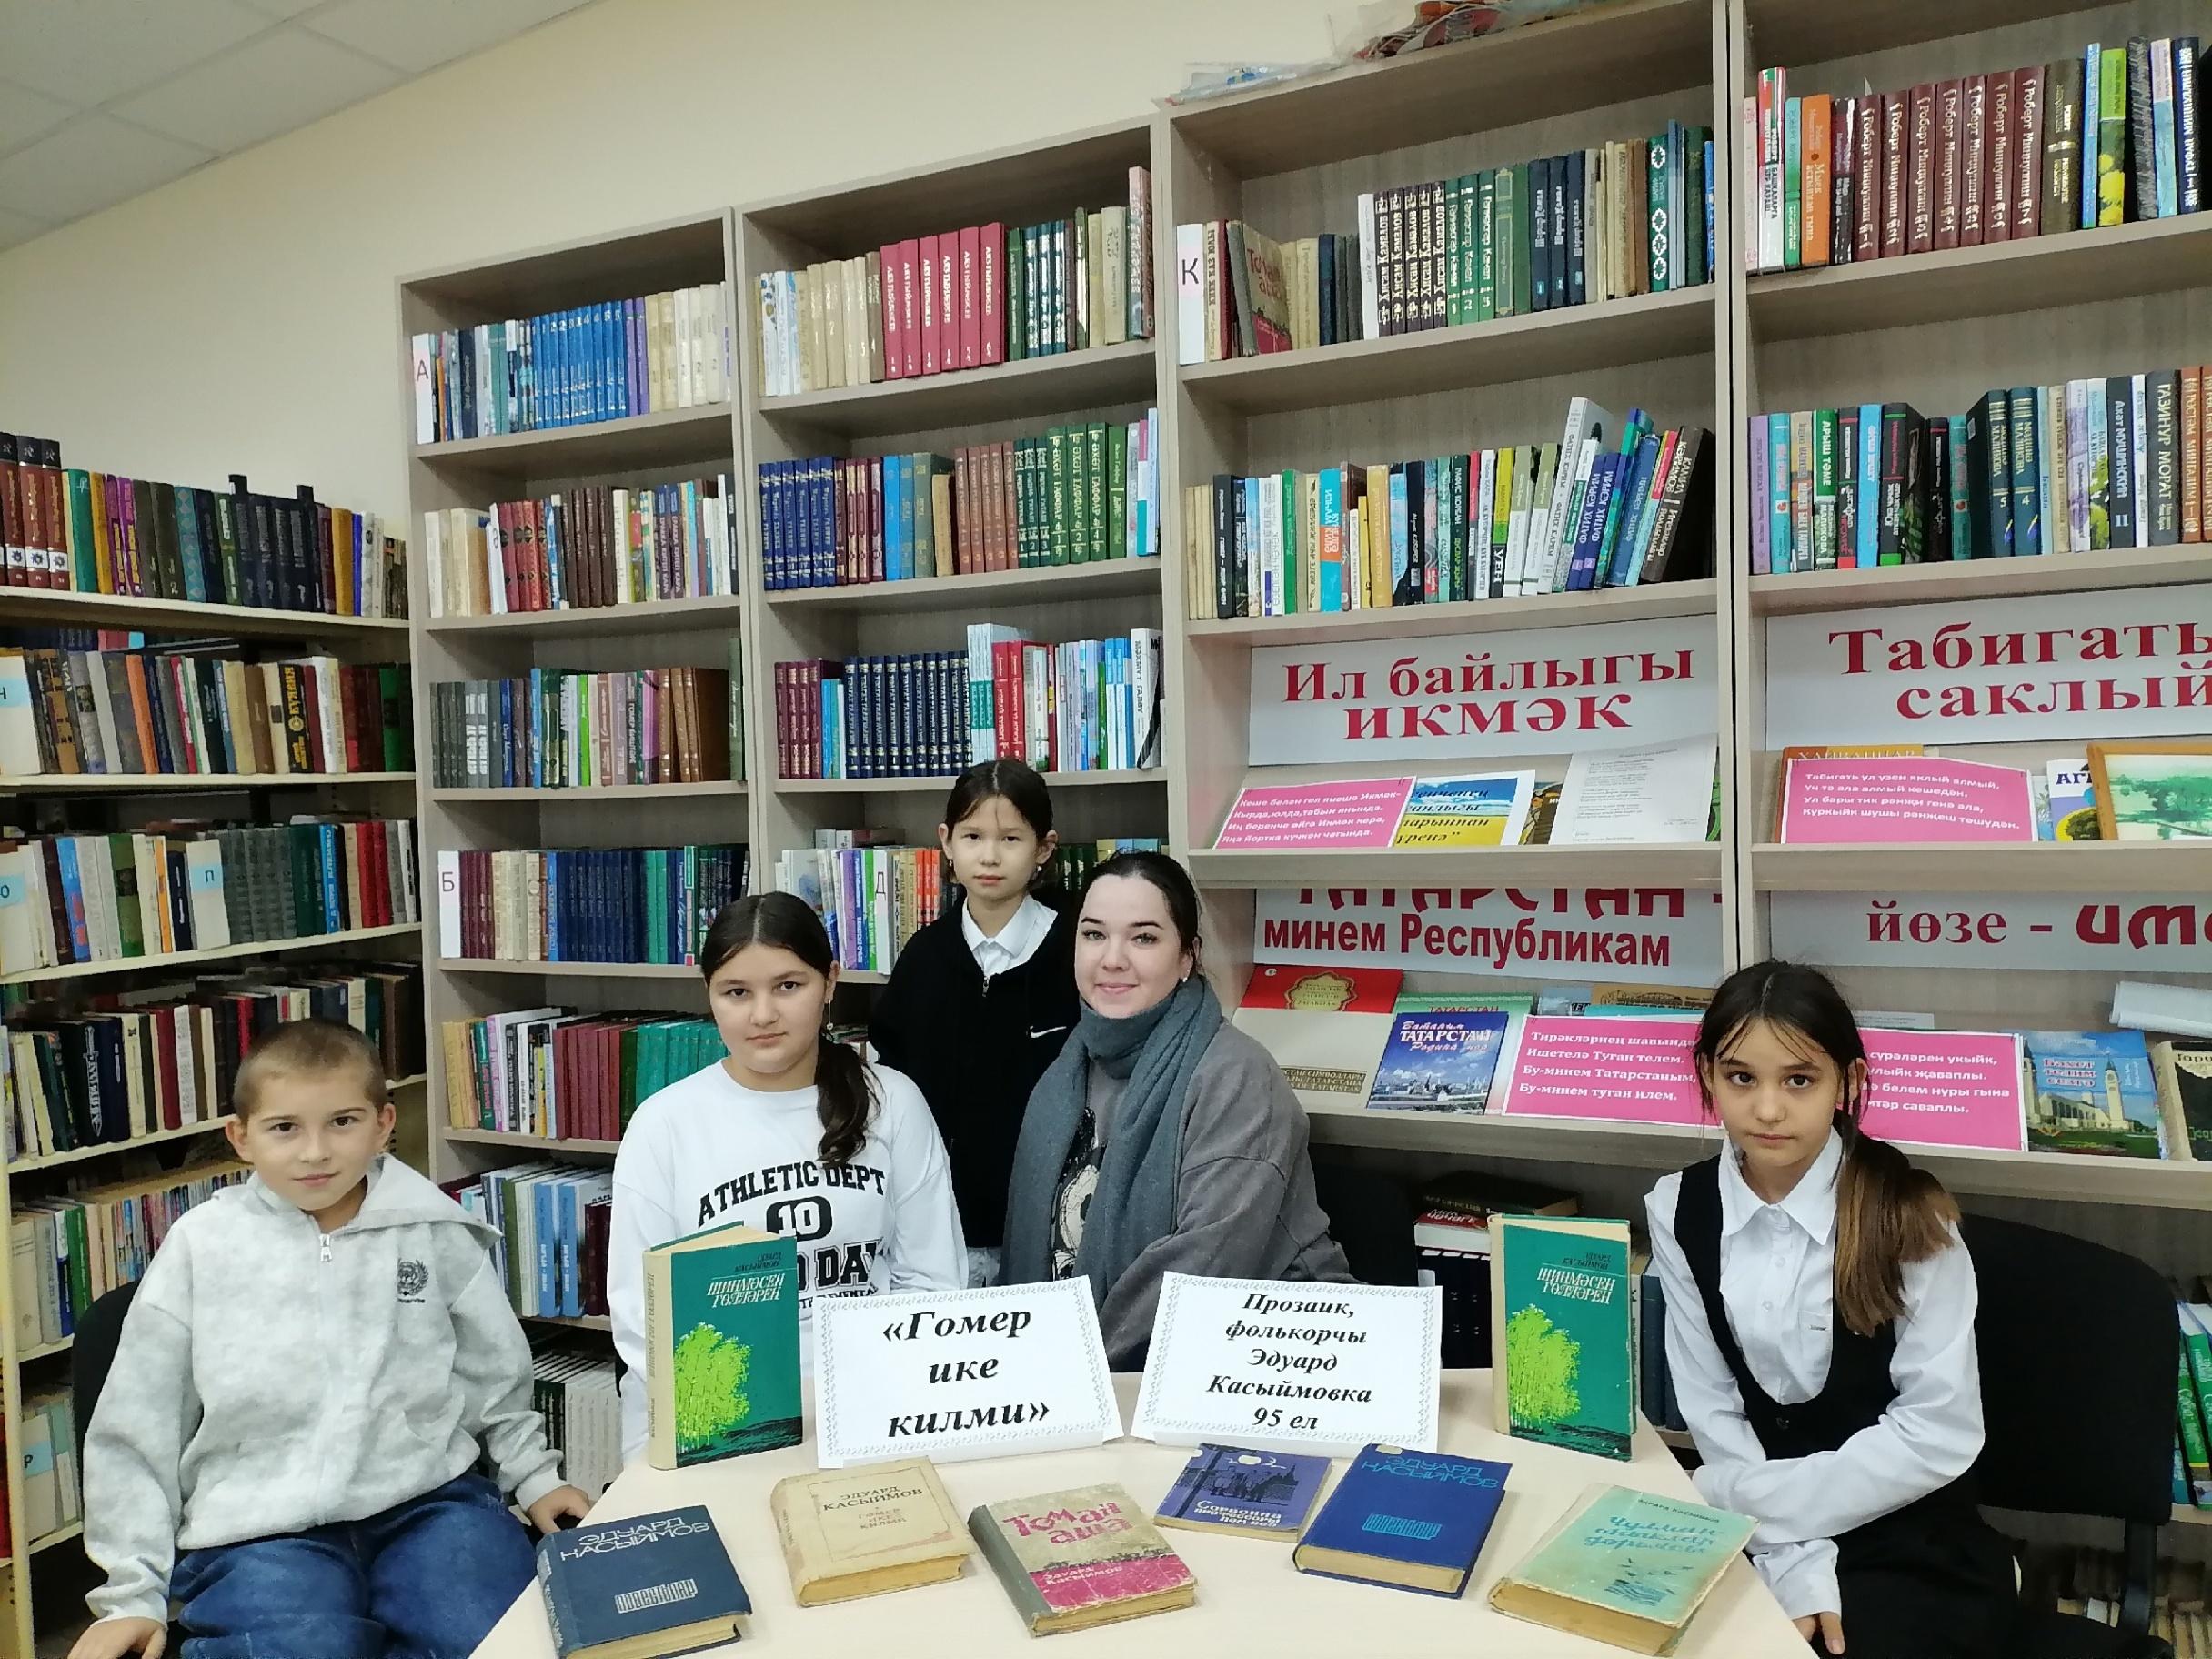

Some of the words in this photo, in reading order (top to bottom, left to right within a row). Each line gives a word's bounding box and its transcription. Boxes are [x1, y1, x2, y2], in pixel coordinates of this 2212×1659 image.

[1941, 98, 1956, 140] Роберт
[2022, 87, 2036, 129] Роберт
[1887, 113, 1903, 152] Роберт
[1181, 257, 1200, 286] К
[416, 359, 430, 382] А
[2157, 383, 2173, 446] ГАЗИНУР
[1822, 420, 1832, 456] АРЫШ
[2157, 450, 2172, 500] МОРАТ
[1492, 547, 1505, 584] УЕН
[1282, 661, 1366, 702] Ил
[1388, 649, 1695, 697] байлыгы
[1342, 693, 1633, 741] икмәк
[441, 871, 455, 892] Б
[1866, 900, 2008, 945] йөзе
[1264, 917, 1387, 953] минем
[1401, 912, 1672, 970] Республикам
[1399, 1030, 1493, 1043] ТАТАРСТАН
[1593, 1051, 1634, 1063] Туган
[1947, 1055, 1998, 1067] укыйк,
[1523, 1065, 1592, 1078] Бу-минем
[1594, 1069, 1697, 1084] Татарстаным,
[1519, 1082, 1588, 1097] Бу-минем
[1592, 1088, 1633, 1100] туган
[1634, 1090, 1678, 1101] илем.
[1882, 1082, 1929, 1095] белем
[1931, 1087, 1971, 1098] нуры
[1973, 1089, 2012, 1098] гына
[1903, 1101, 1971, 1114] саваплы.
[698, 1161, 819, 1229] ATHLETIC
[823, 1162, 886, 1197] DEPT
[778, 1200, 823, 1238] 10
[1242, 1293, 1355, 1319] Прозаик,
[883, 1311, 1031, 1342] «Гомер
[1225, 1320, 1368, 1347] фолькорчы
[929, 1358, 1000, 1384] ике
[1246, 1348, 1338, 1375] Эдуард
[1206, 1375, 1373, 1403] Касыймовка
[888, 1401, 1050, 1437] килми»
[1252, 1407, 1284, 1428] 95
[1289, 1414, 1321, 1431] ел
[1386, 1456, 1483, 1477] ЭДУАРД
[822, 1488, 924, 1512] КАСЫЙМОВ
[840, 1485, 900, 1500] ЭДУАРД
[578, 1516, 686, 1546] ЭДУАРД
[1046, 1518, 1133, 1546] аша
